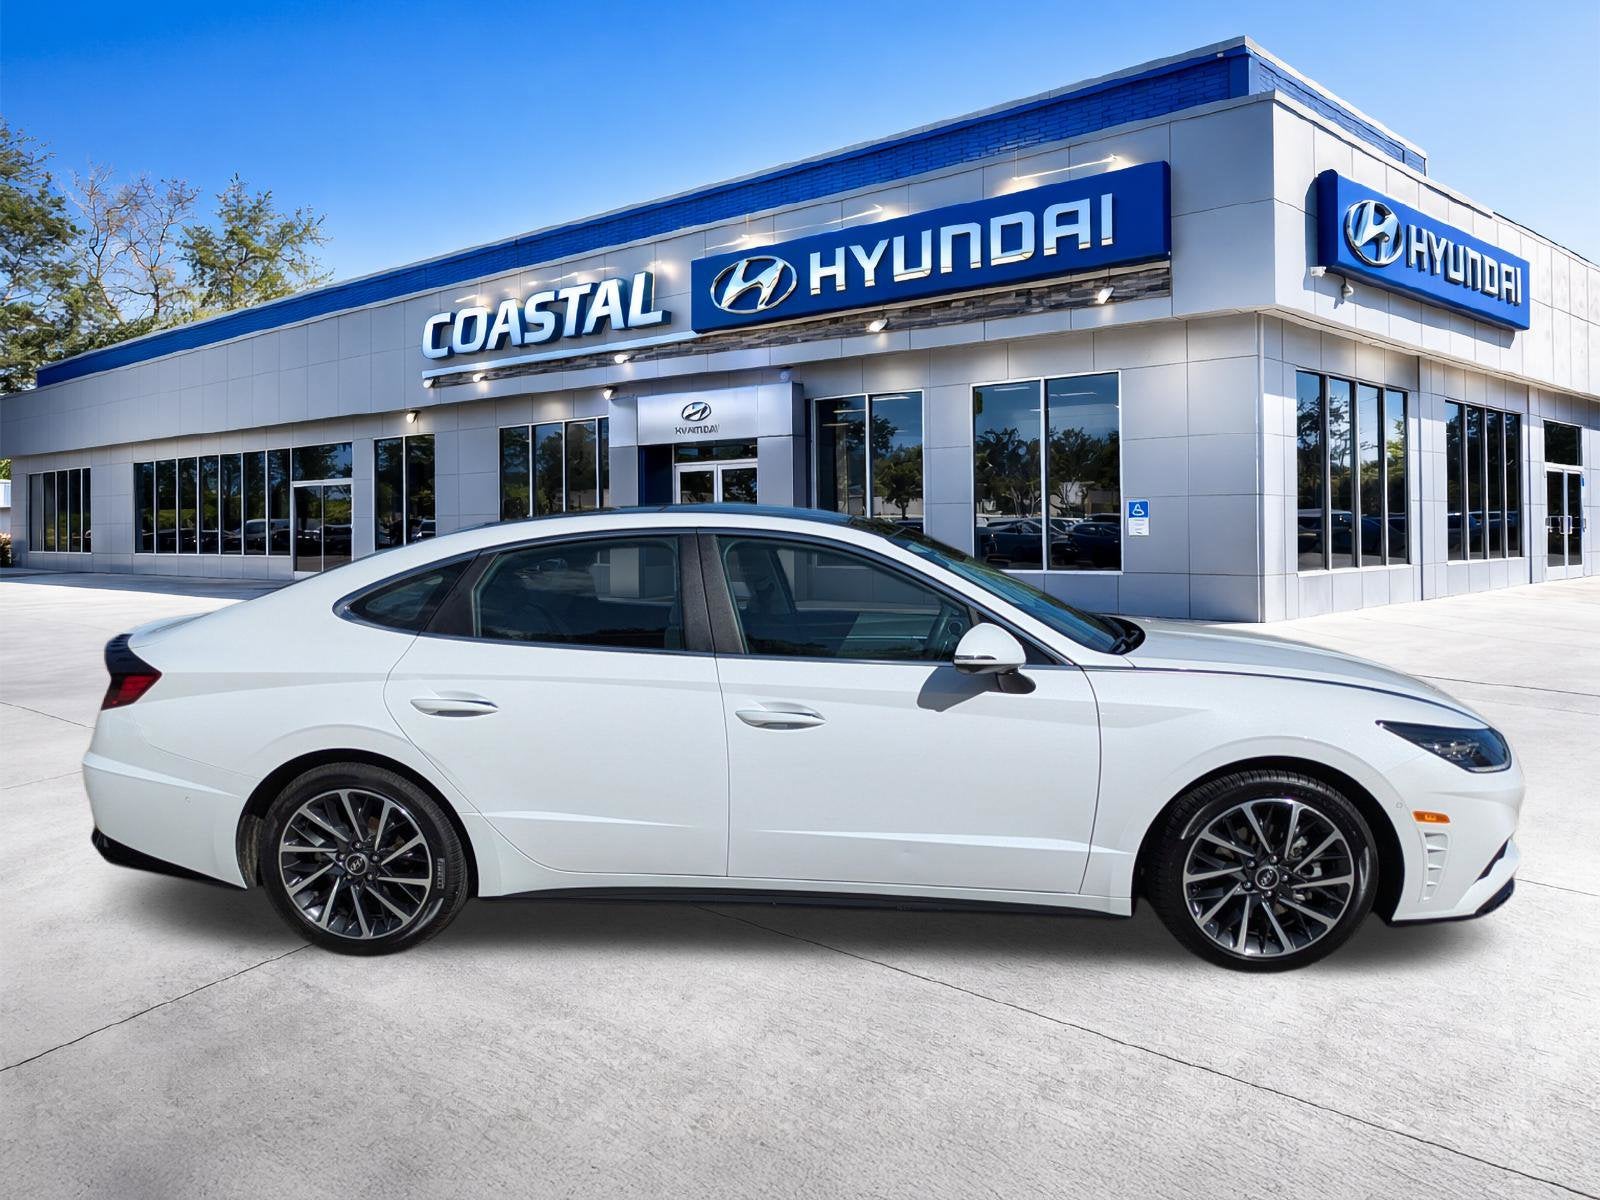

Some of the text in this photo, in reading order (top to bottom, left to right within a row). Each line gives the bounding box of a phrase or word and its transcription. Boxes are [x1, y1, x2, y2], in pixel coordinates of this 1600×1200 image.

[809, 192, 1114, 295] HYUNDAI
[1407, 224, 1522, 306] HYUNDAI
[422, 271, 667, 360] COASTAL
